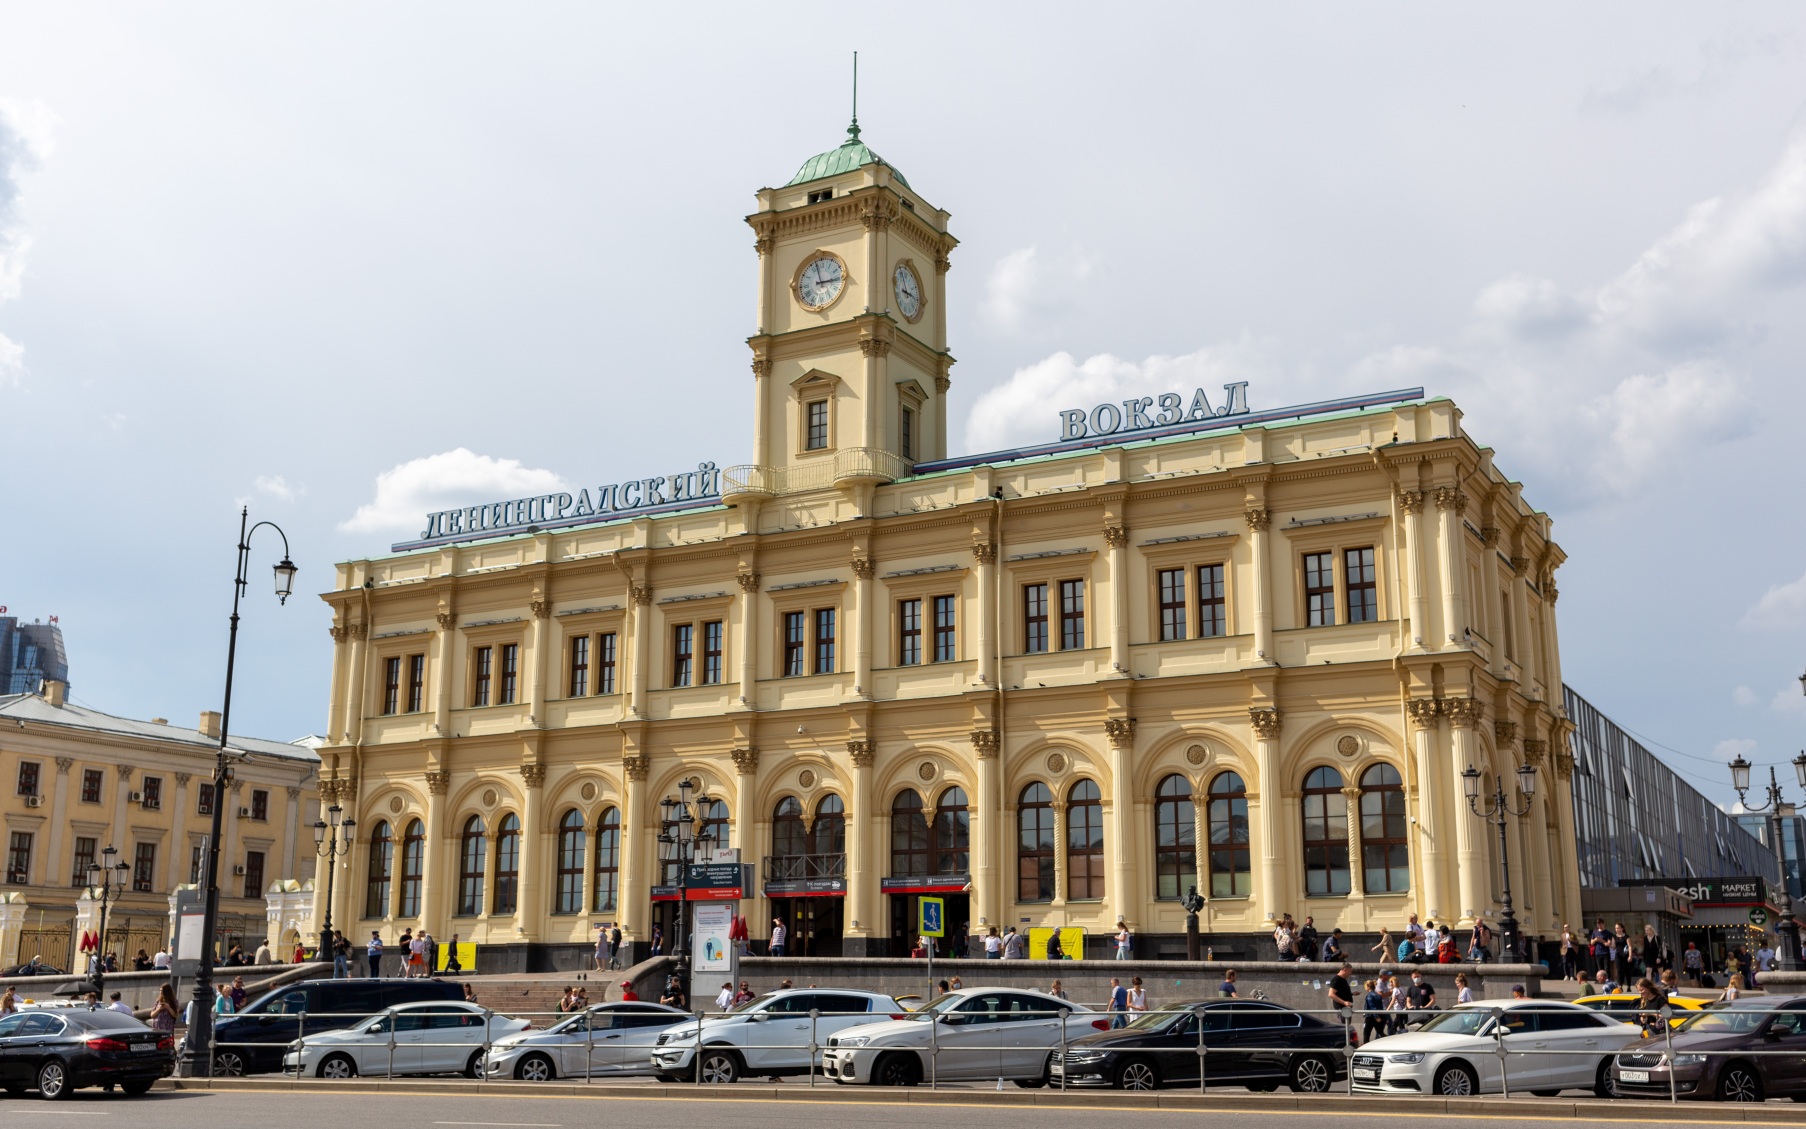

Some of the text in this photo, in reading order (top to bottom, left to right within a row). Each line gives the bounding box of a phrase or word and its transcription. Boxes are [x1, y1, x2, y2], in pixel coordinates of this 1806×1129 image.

[1059, 381, 1250, 442] ВОКЗАЛ
[420, 461, 720, 540] ЛЕНИНГРАДСКИЙ
[1721, 884, 1756, 892] МАРКЕТ
